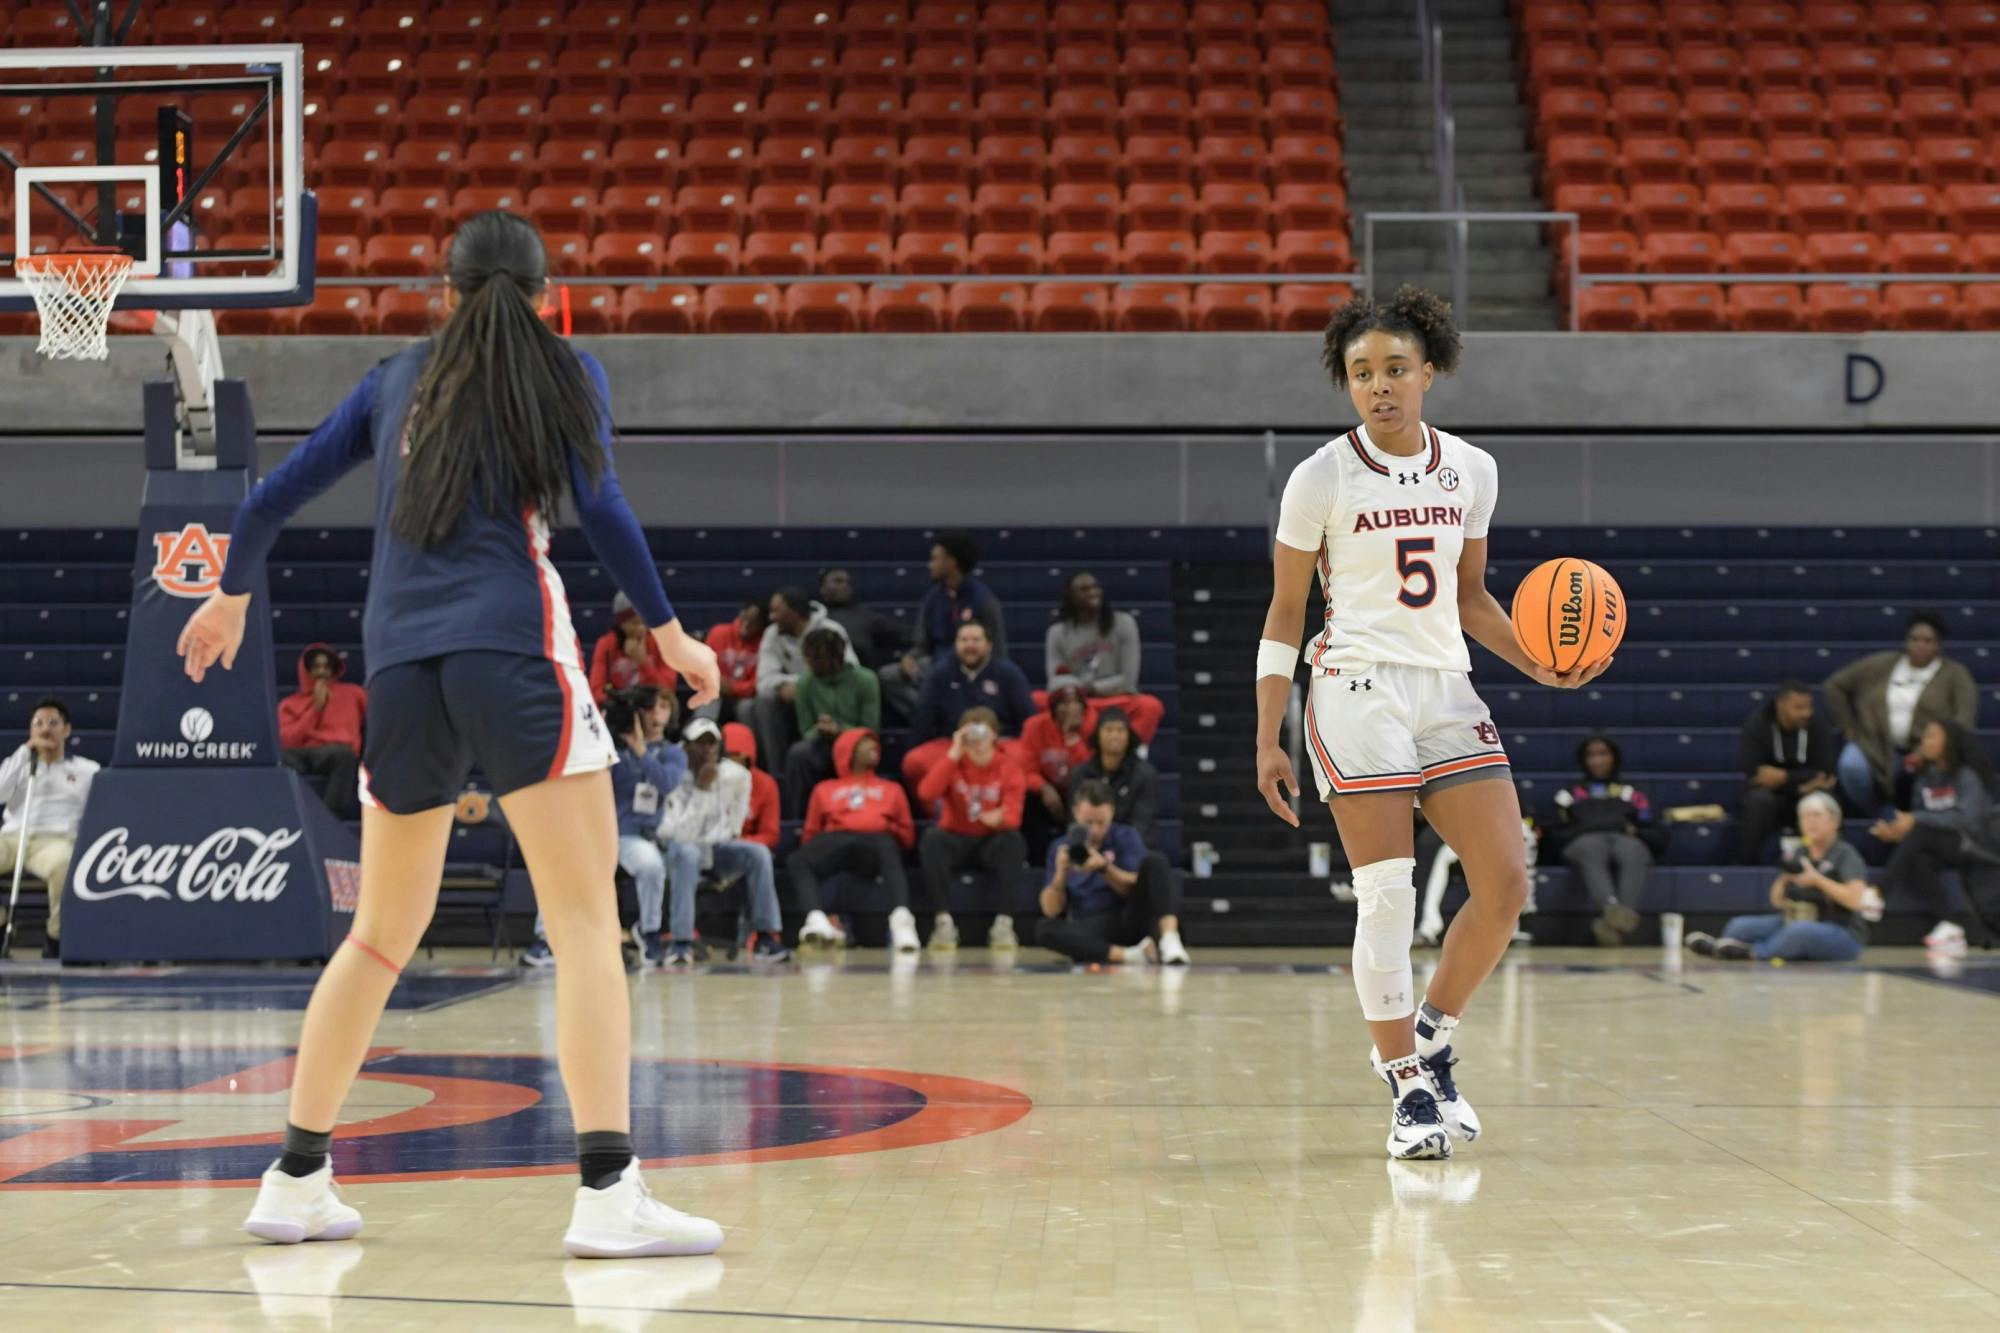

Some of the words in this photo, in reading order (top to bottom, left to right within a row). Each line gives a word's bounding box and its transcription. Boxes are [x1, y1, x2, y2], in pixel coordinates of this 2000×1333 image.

[1845, 353, 1885, 405] D
[1439, 468, 1459, 491] SEC
[1352, 506, 1463, 534] AUBURN
[1395, 536, 1438, 611] 5
[1559, 571, 1583, 647] Wilson
[135, 741, 190, 759] WIND
[192, 741, 253, 759] CREEK
[73, 826, 303, 903] Coca-Cola
